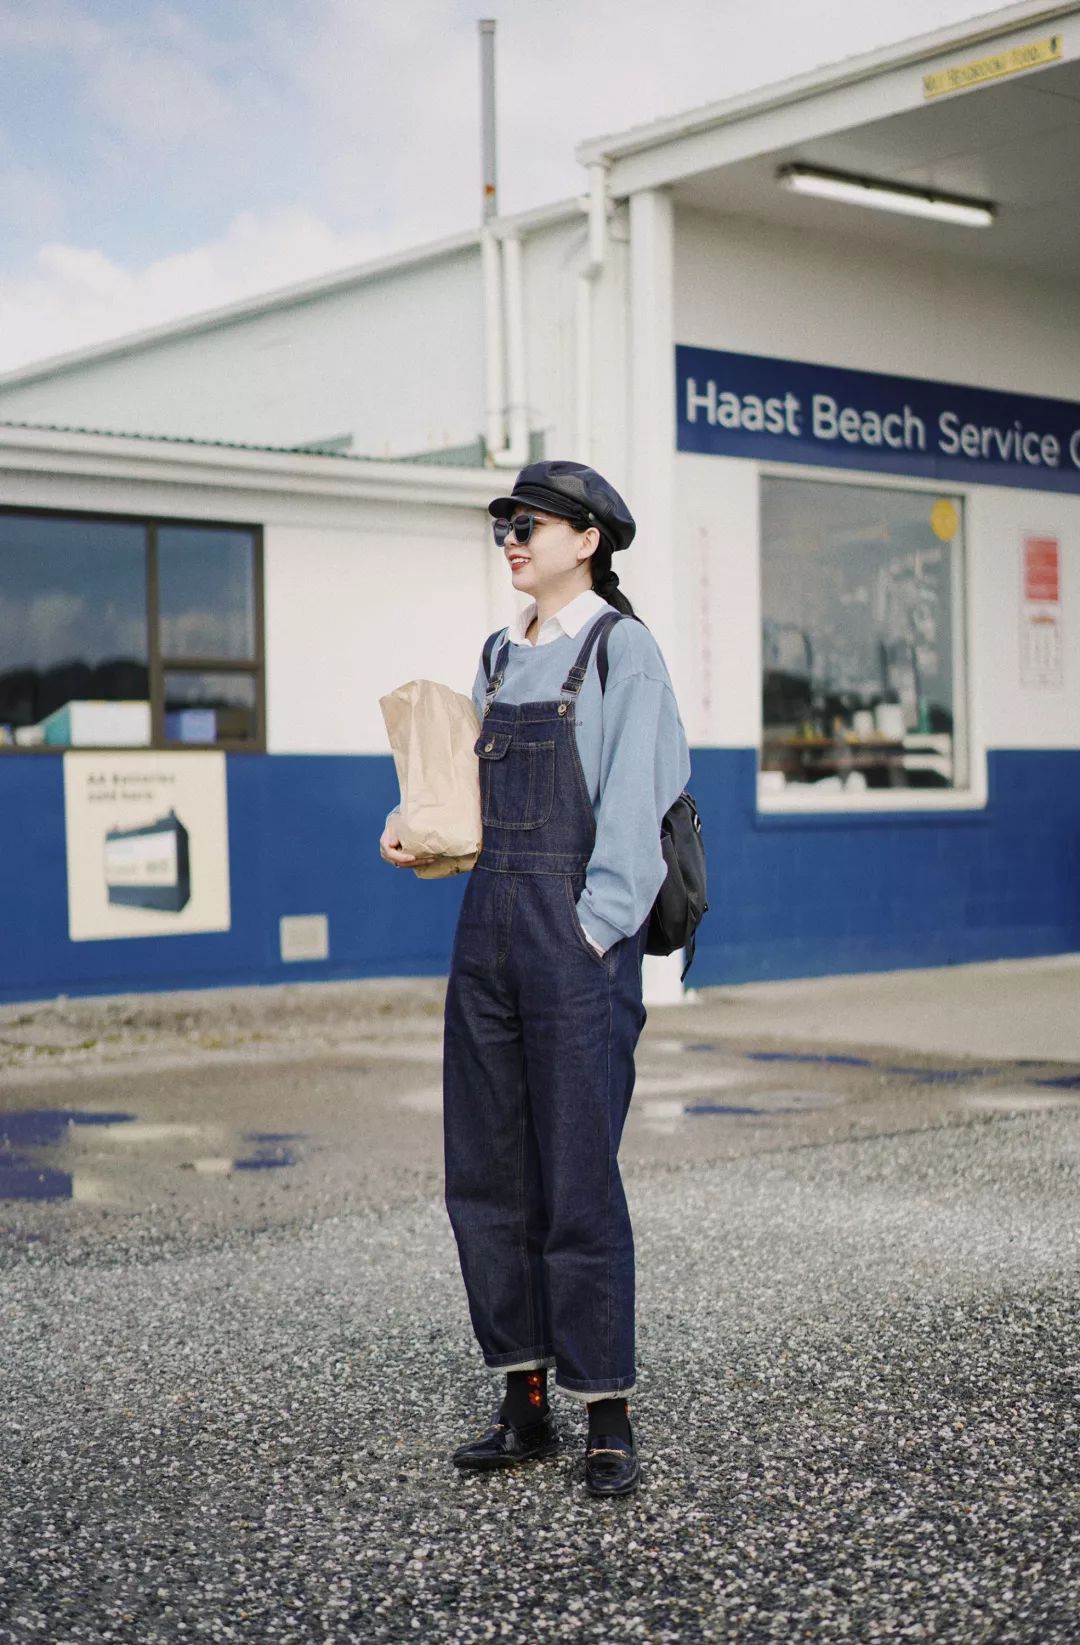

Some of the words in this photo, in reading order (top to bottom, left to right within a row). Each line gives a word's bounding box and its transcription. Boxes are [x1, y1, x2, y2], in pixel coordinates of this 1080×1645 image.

[686, 377, 800, 436] Haast
[812, 394, 926, 449] Beach
[938, 411, 1061, 467] Service
